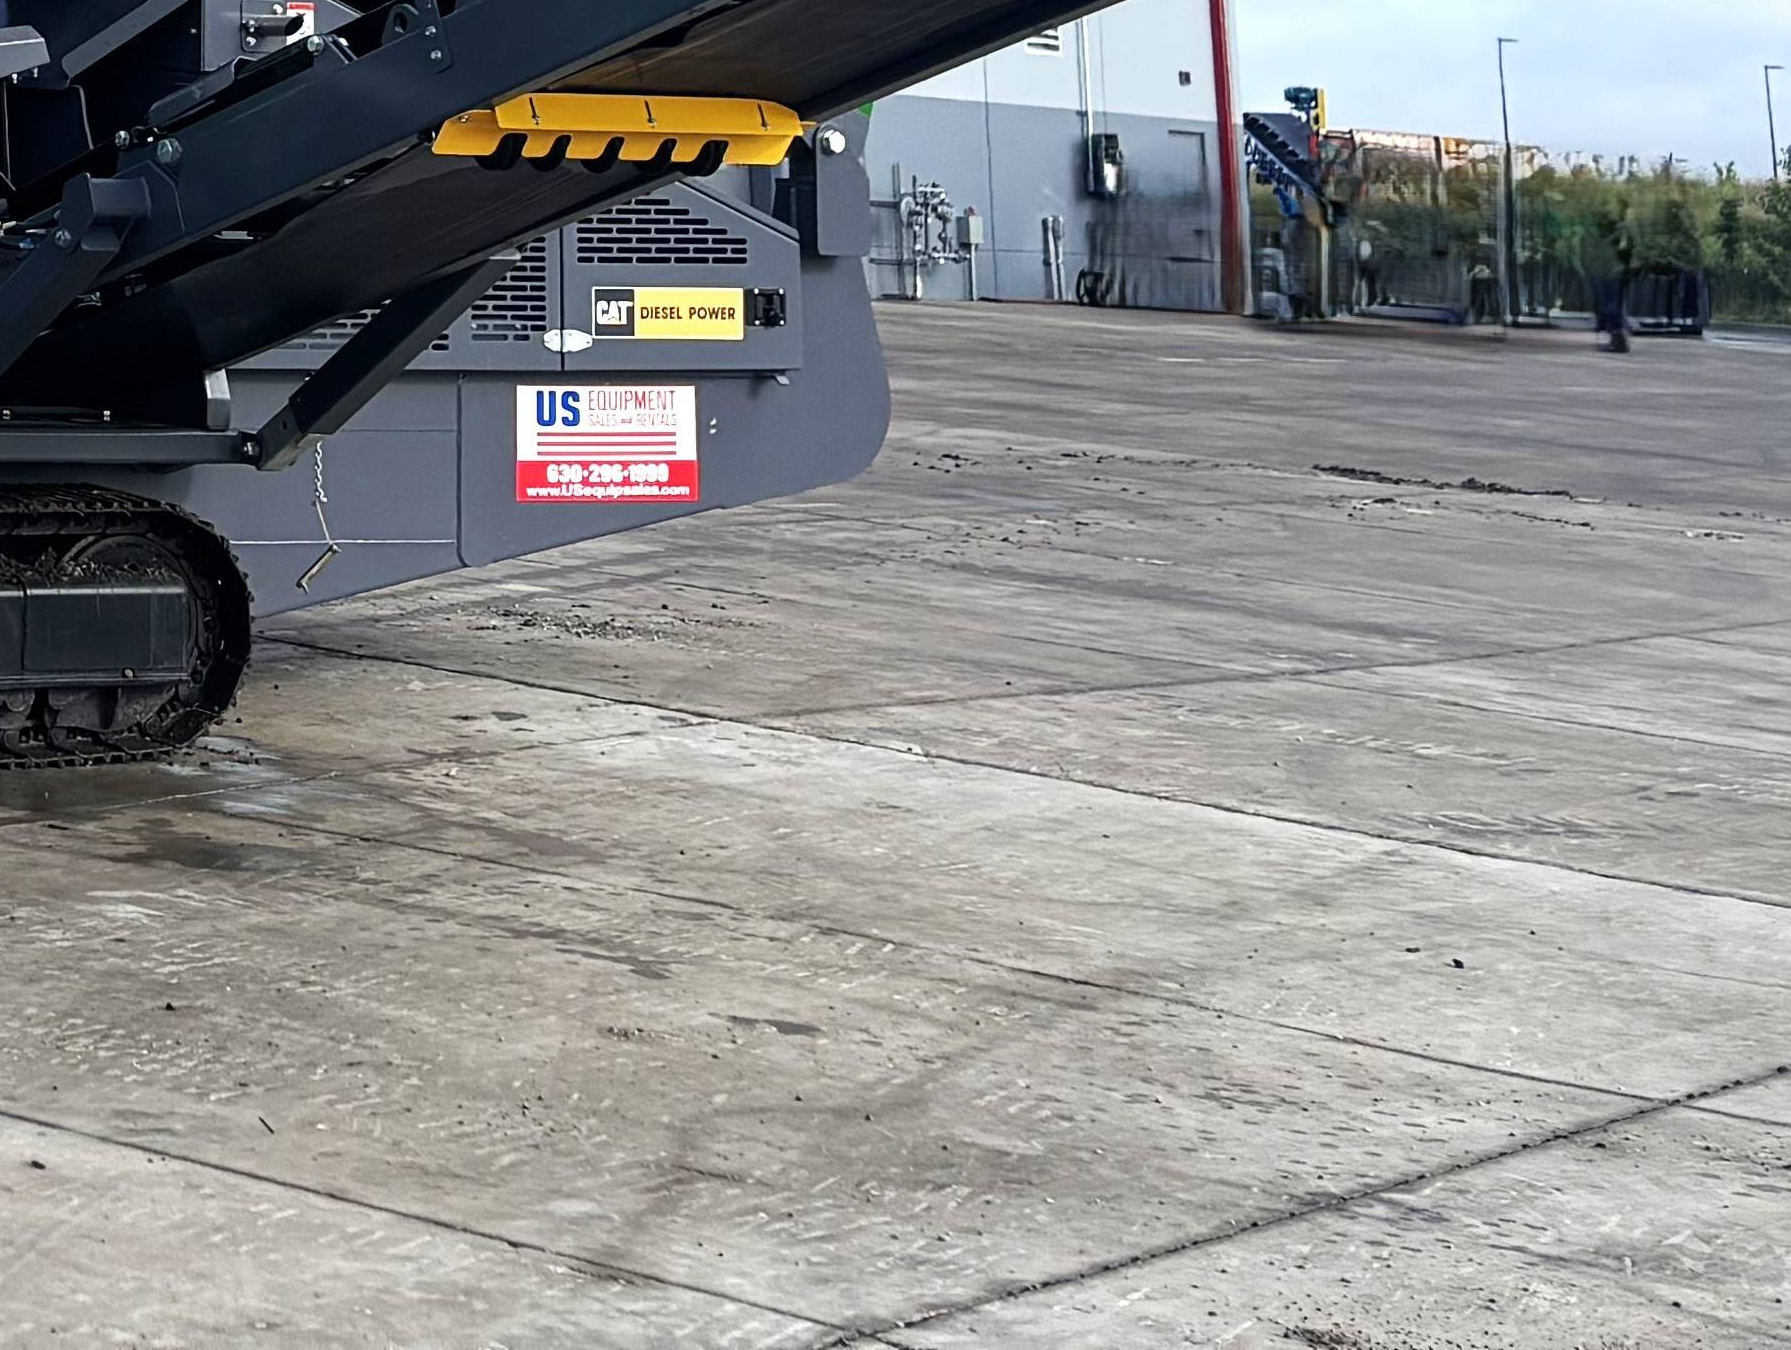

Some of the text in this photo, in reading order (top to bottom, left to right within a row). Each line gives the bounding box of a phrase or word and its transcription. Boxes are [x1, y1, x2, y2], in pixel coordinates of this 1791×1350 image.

[596, 300, 736, 325] CAT DIESEL POWER
[536, 390, 677, 427] US EQUIPMENT
[588, 413, 617, 427] SALES
